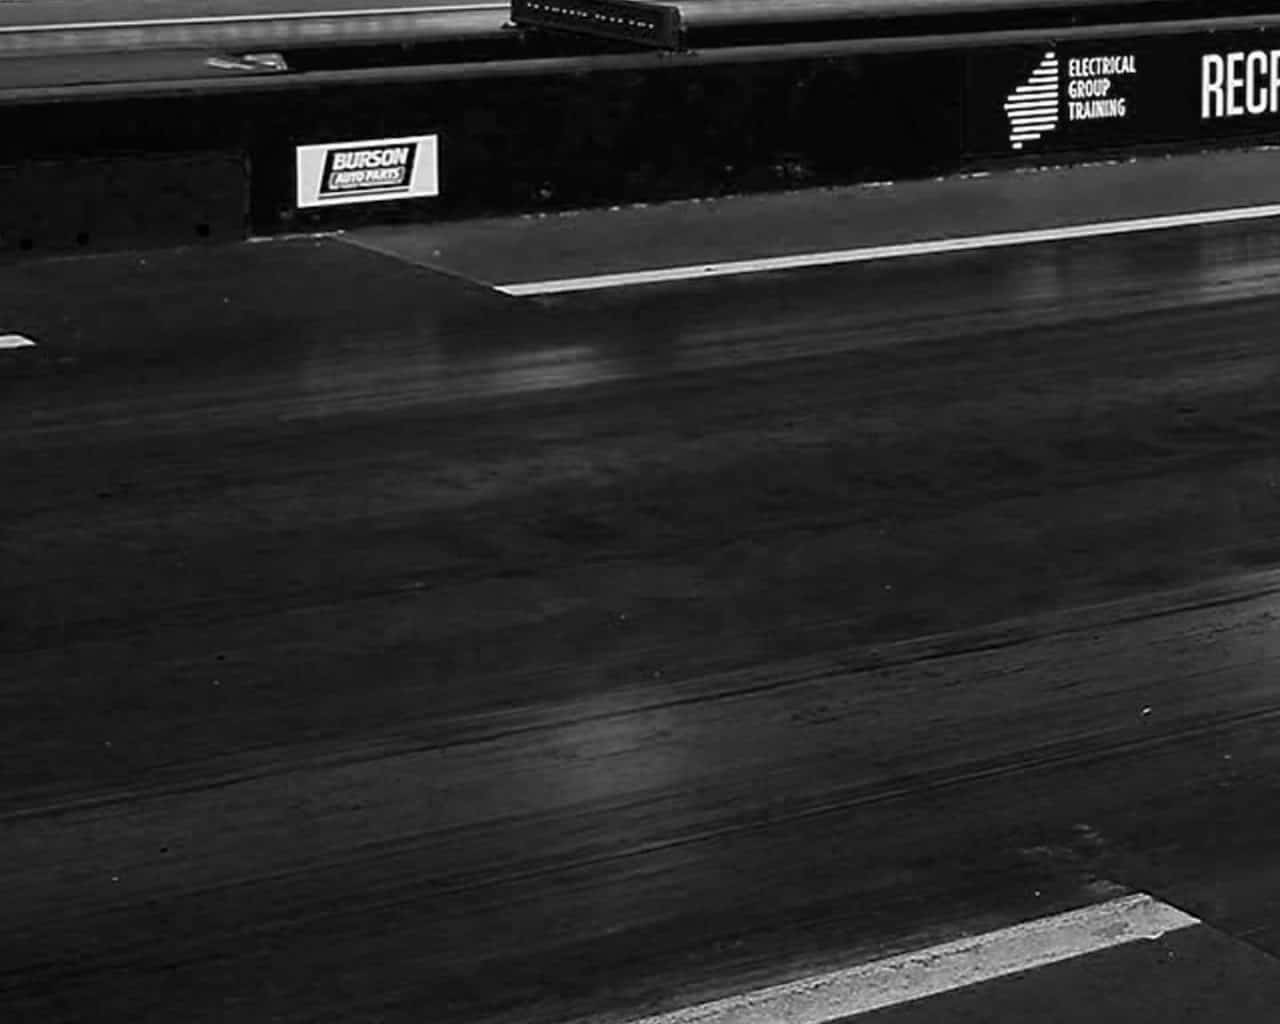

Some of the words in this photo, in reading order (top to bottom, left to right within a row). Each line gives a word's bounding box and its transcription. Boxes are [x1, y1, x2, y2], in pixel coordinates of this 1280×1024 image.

[1068, 55, 1137, 77] ELECTRICAL
[1068, 77, 1111, 98] GROUP
[1068, 97, 1126, 121] TRAINING
[332, 146, 410, 171] BURSON
